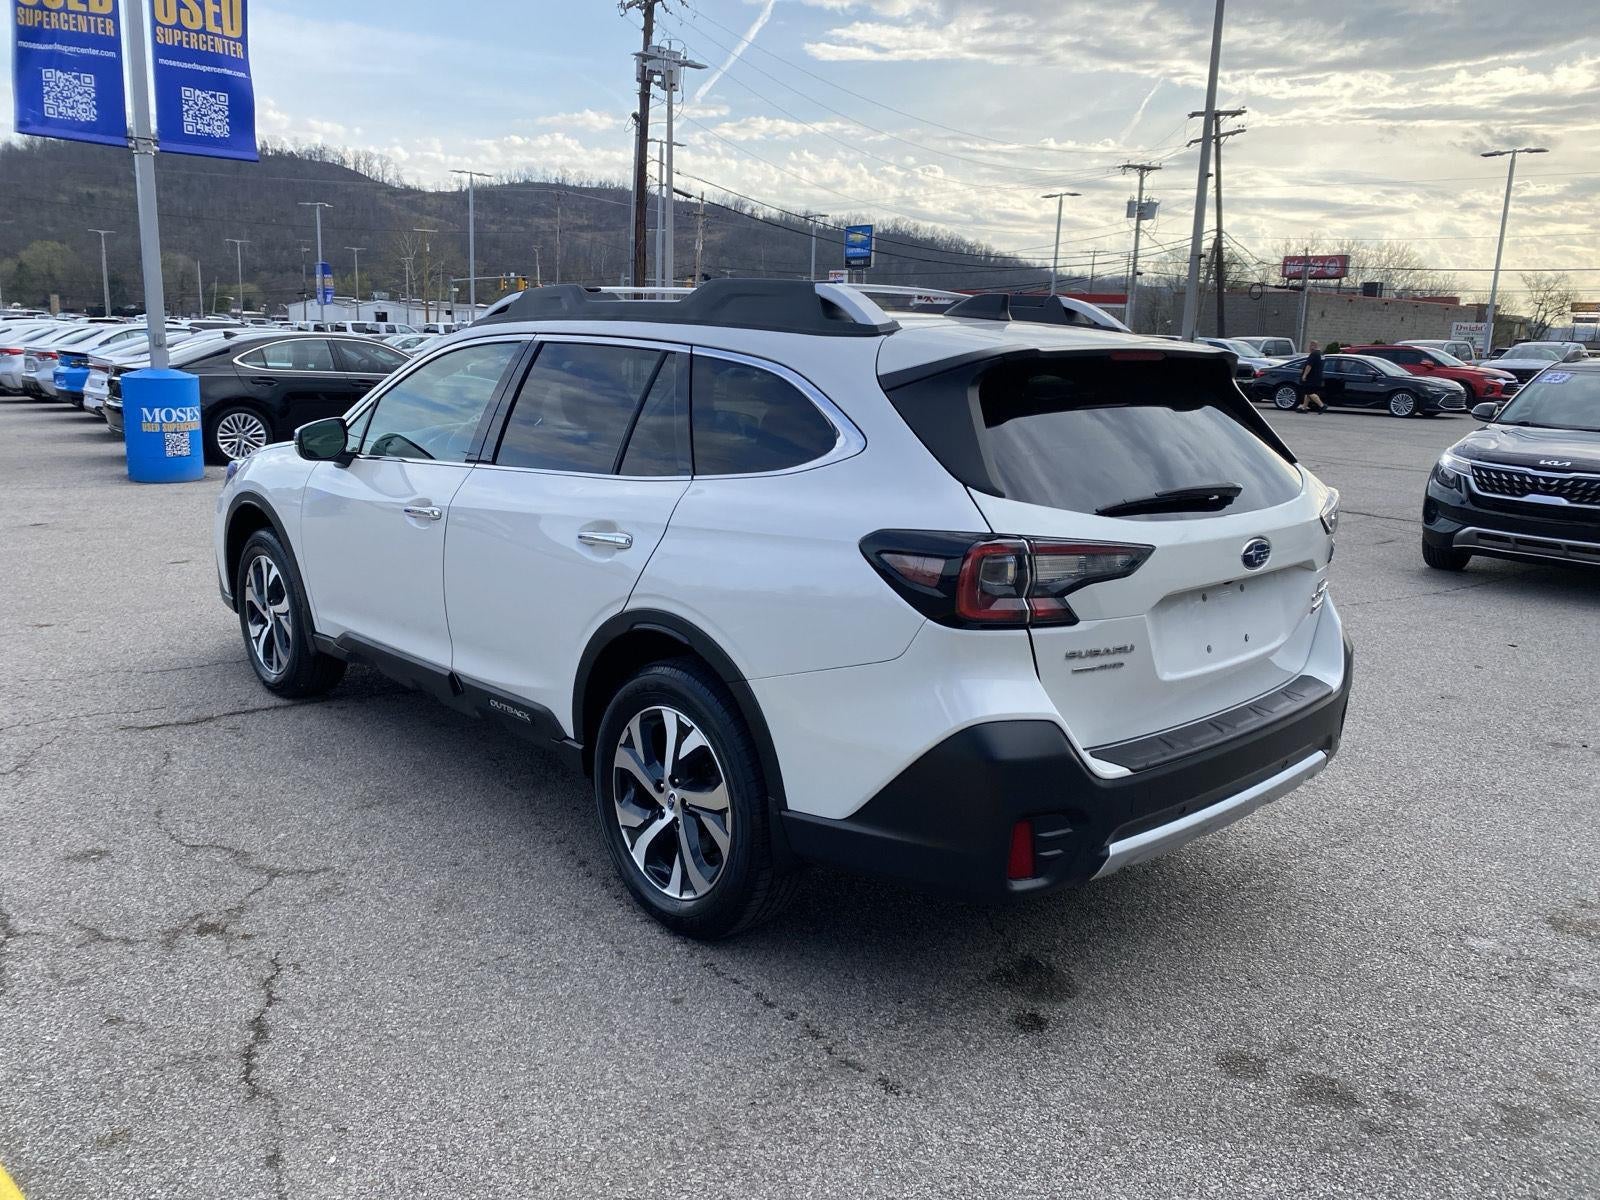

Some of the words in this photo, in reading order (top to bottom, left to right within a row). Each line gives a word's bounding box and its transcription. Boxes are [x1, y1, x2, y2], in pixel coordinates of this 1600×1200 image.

[17, 7, 115, 37] SUPERCENTER
[155, 0, 242, 38] USED
[18, 40, 117, 58] mosesusedsupercenter.com
[156, 26, 244, 59] SUPERCENTER
[141, 406, 200, 423] MOSES
[1065, 643, 1135, 660] SUBARU
[490, 699, 531, 722] OUTBACK
